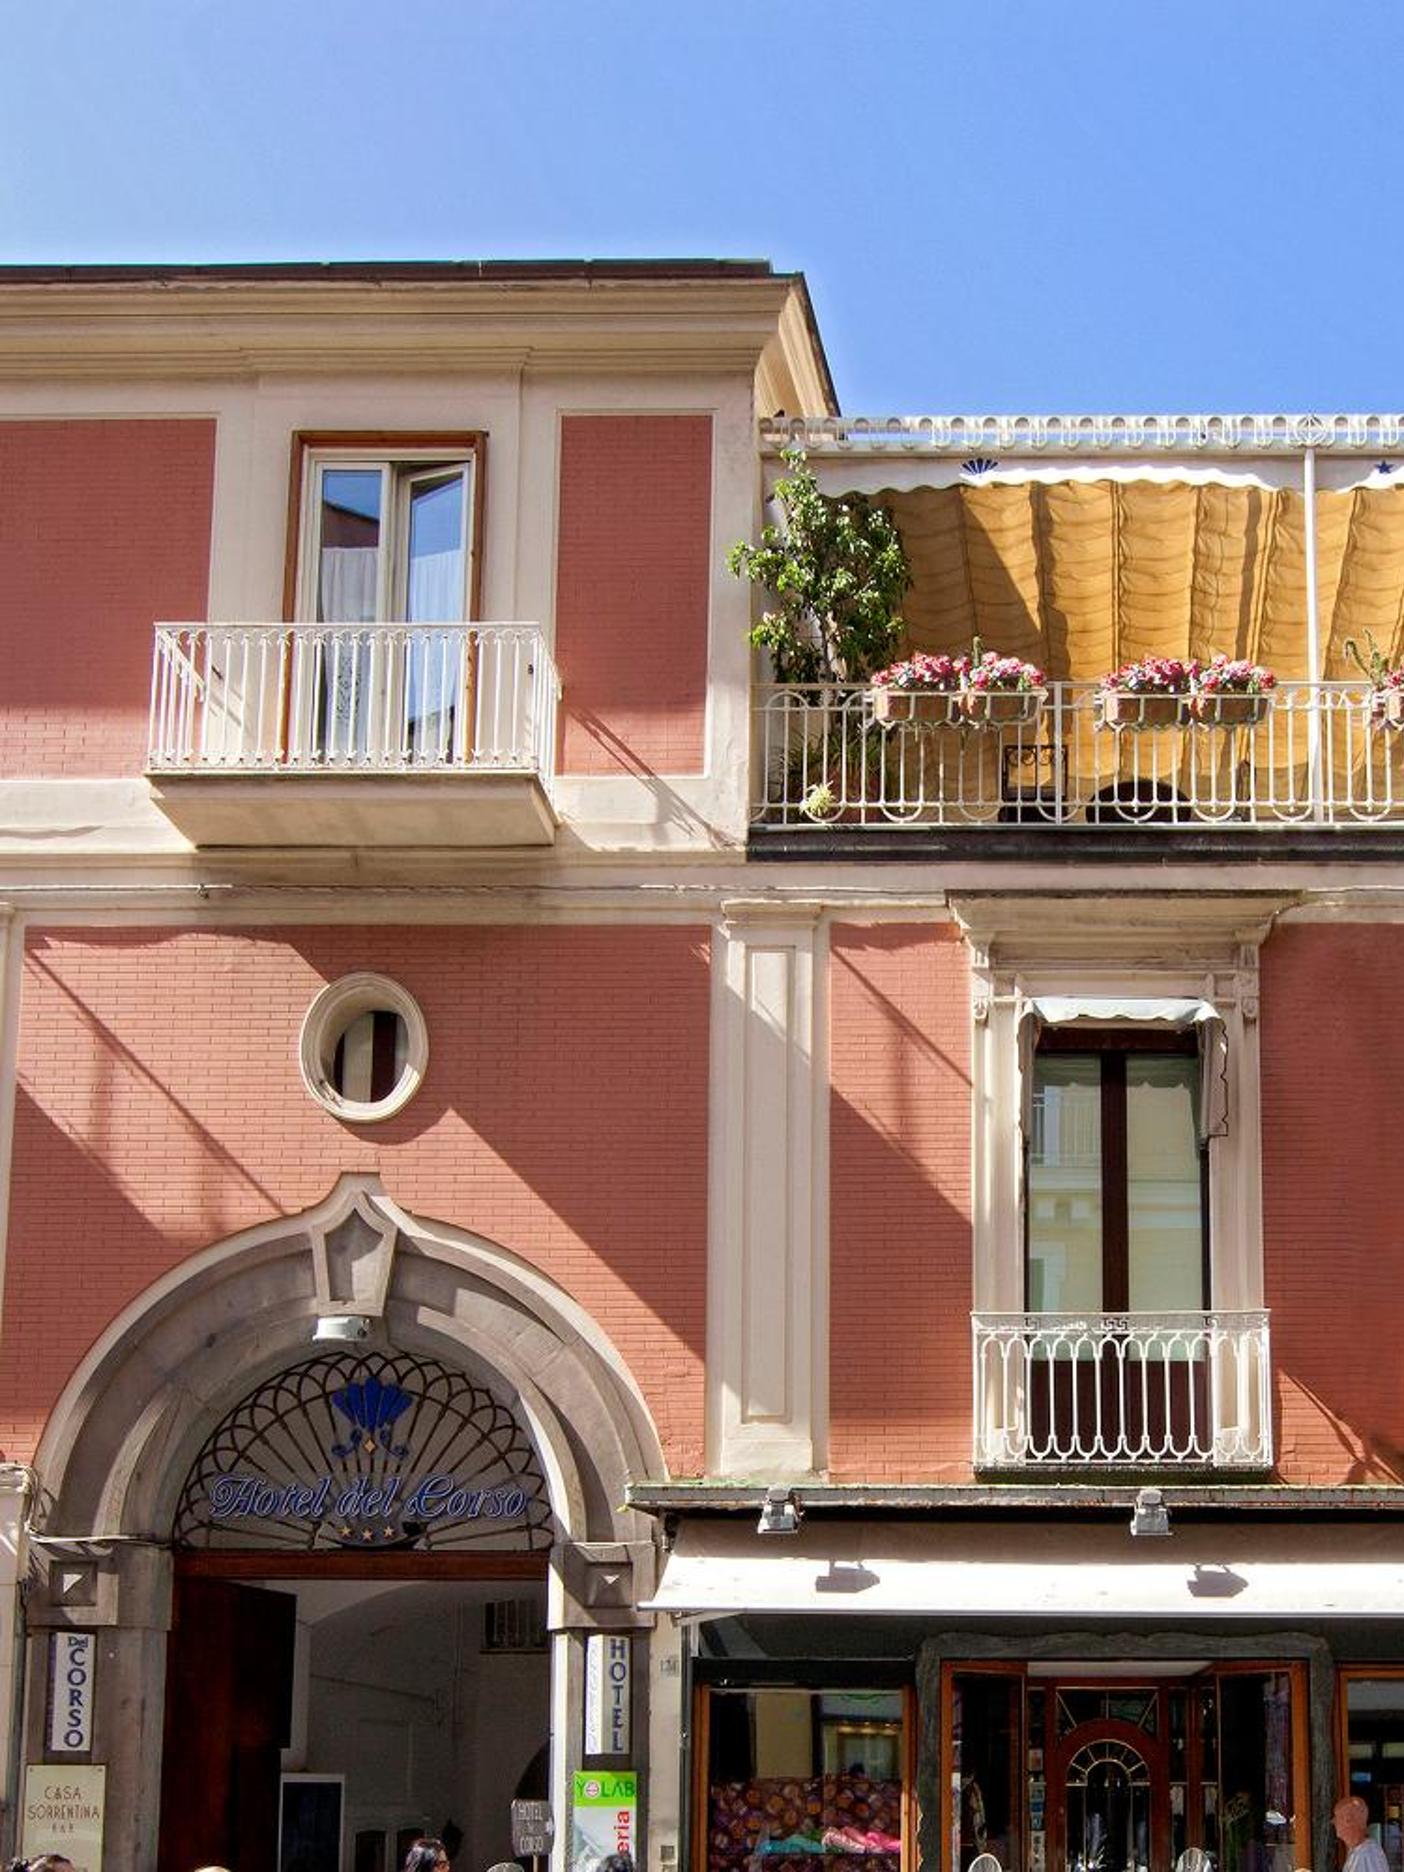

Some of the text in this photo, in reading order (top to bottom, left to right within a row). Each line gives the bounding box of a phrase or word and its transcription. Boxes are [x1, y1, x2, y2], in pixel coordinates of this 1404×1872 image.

[208, 1473, 528, 1519] Hotel del Corso
[67, 1635, 89, 1649] Del
[64, 1647, 87, 1748] CORSO
[609, 1637, 627, 1752] HOTEL
[44, 1785, 82, 1801] CASA
[28, 1803, 100, 1821] SORRENTINA
